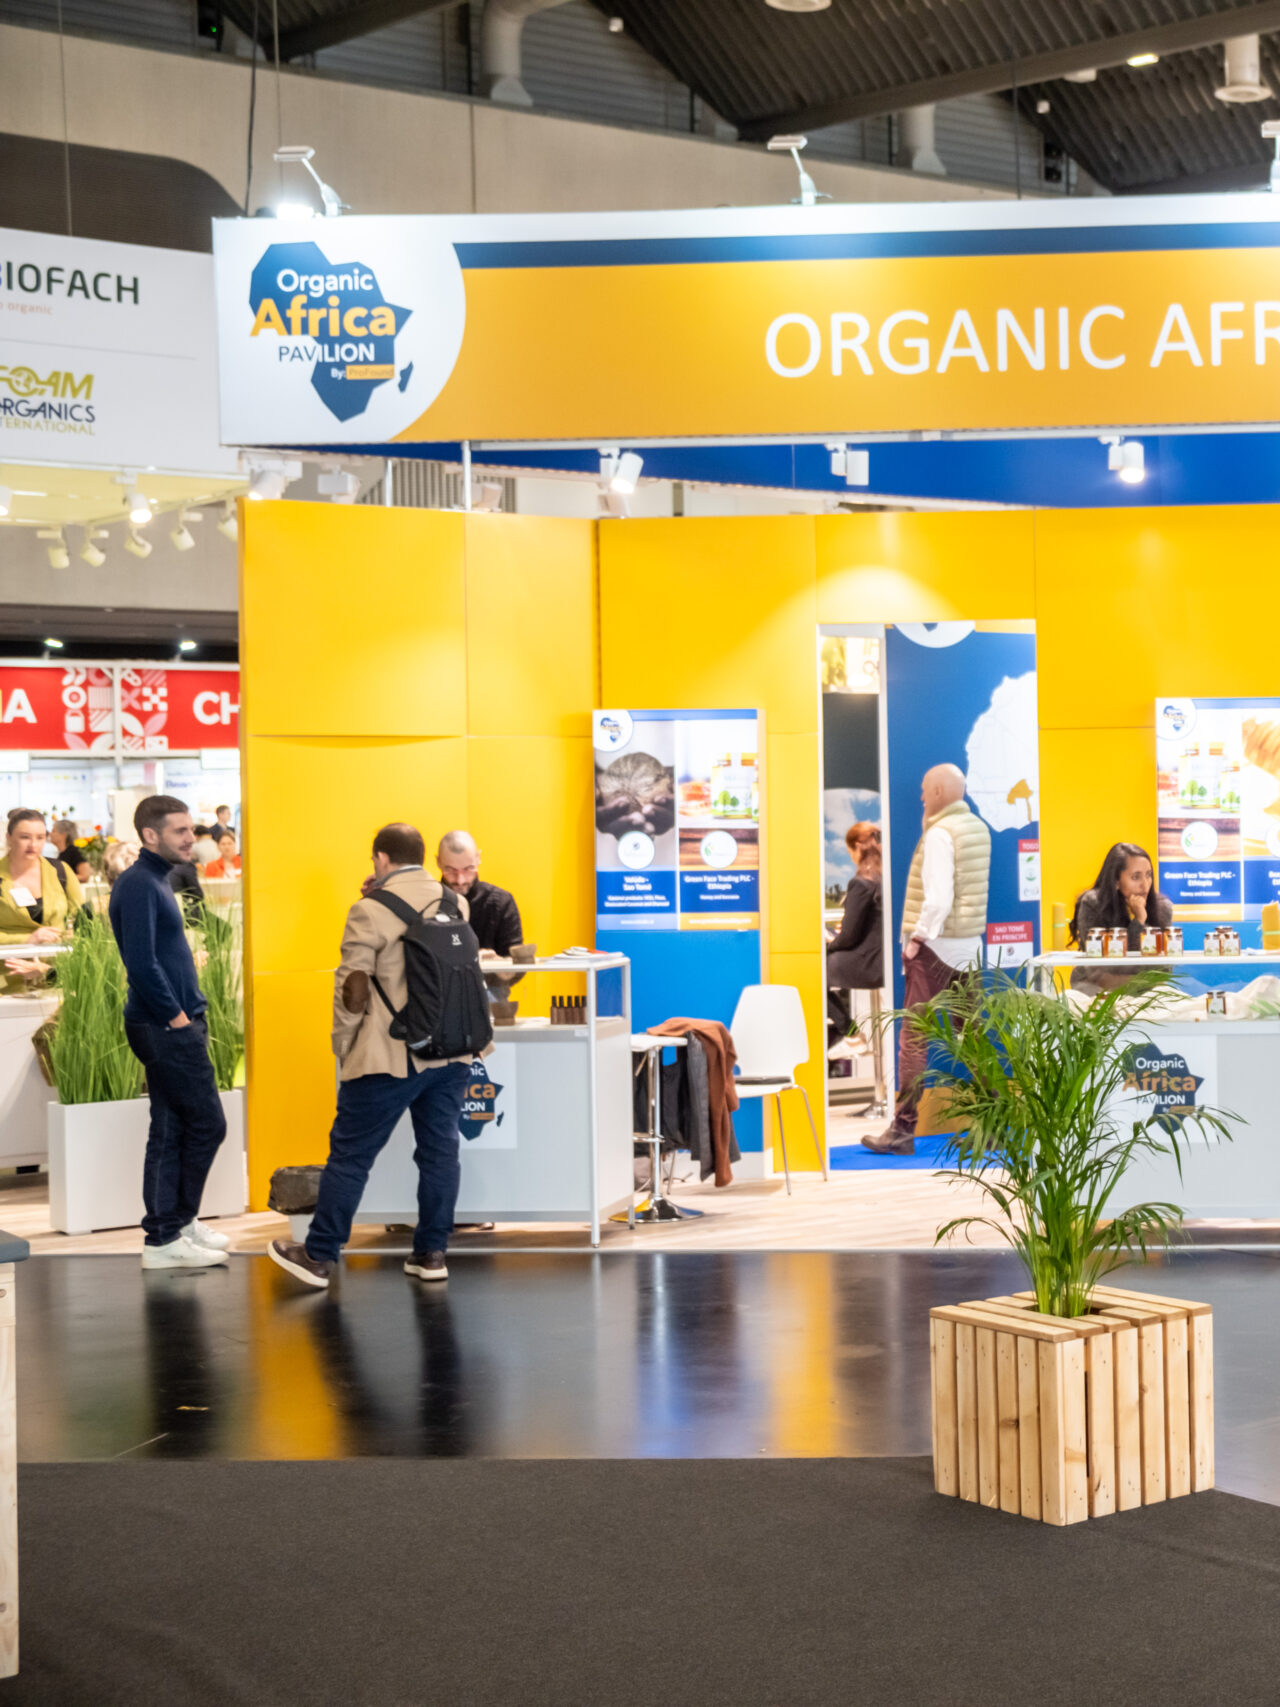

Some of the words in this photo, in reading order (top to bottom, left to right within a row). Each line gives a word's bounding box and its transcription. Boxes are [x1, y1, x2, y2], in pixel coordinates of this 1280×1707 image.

[0, 261, 139, 305] IOFACH
[276, 268, 374, 298] Organic
[249, 294, 396, 337] Africa
[279, 342, 375, 363] PAVILION
[765, 304, 1126, 378] ORGANIC
[0, 397, 96, 423] RGANICS
[0, 417, 96, 437] ERNATIONAL
[1135, 1057, 1185, 1072] Organic
[1121, 1070, 1196, 1093] Africa
